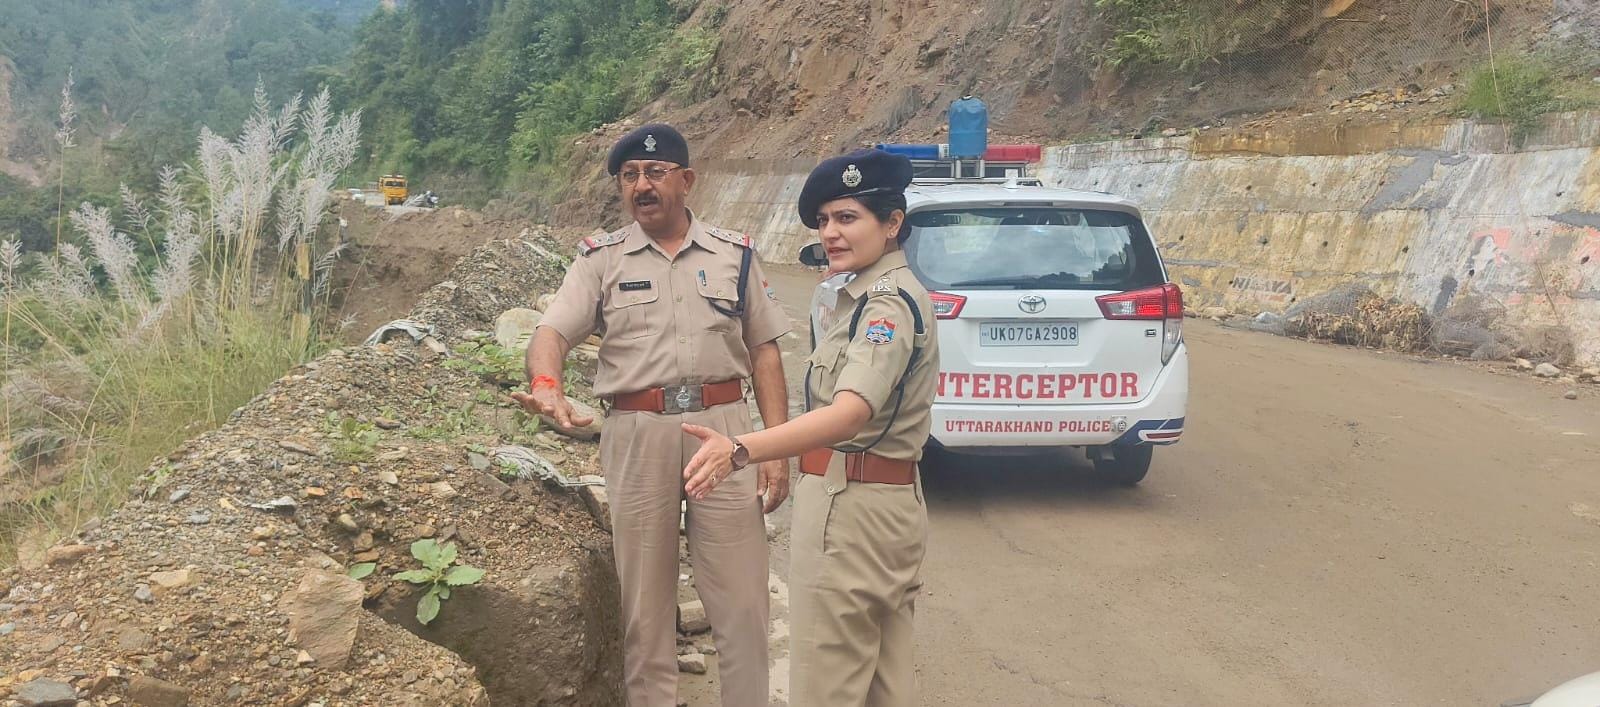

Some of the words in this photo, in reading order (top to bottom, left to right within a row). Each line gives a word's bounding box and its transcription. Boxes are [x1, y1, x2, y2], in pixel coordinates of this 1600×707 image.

[990, 326, 1077, 341] UK07GA2908
[936, 371, 1139, 399] NTERCEPTOR
[945, 420, 1053, 433] UTTARAKHAND
[1058, 420, 1111, 432] POLICE
